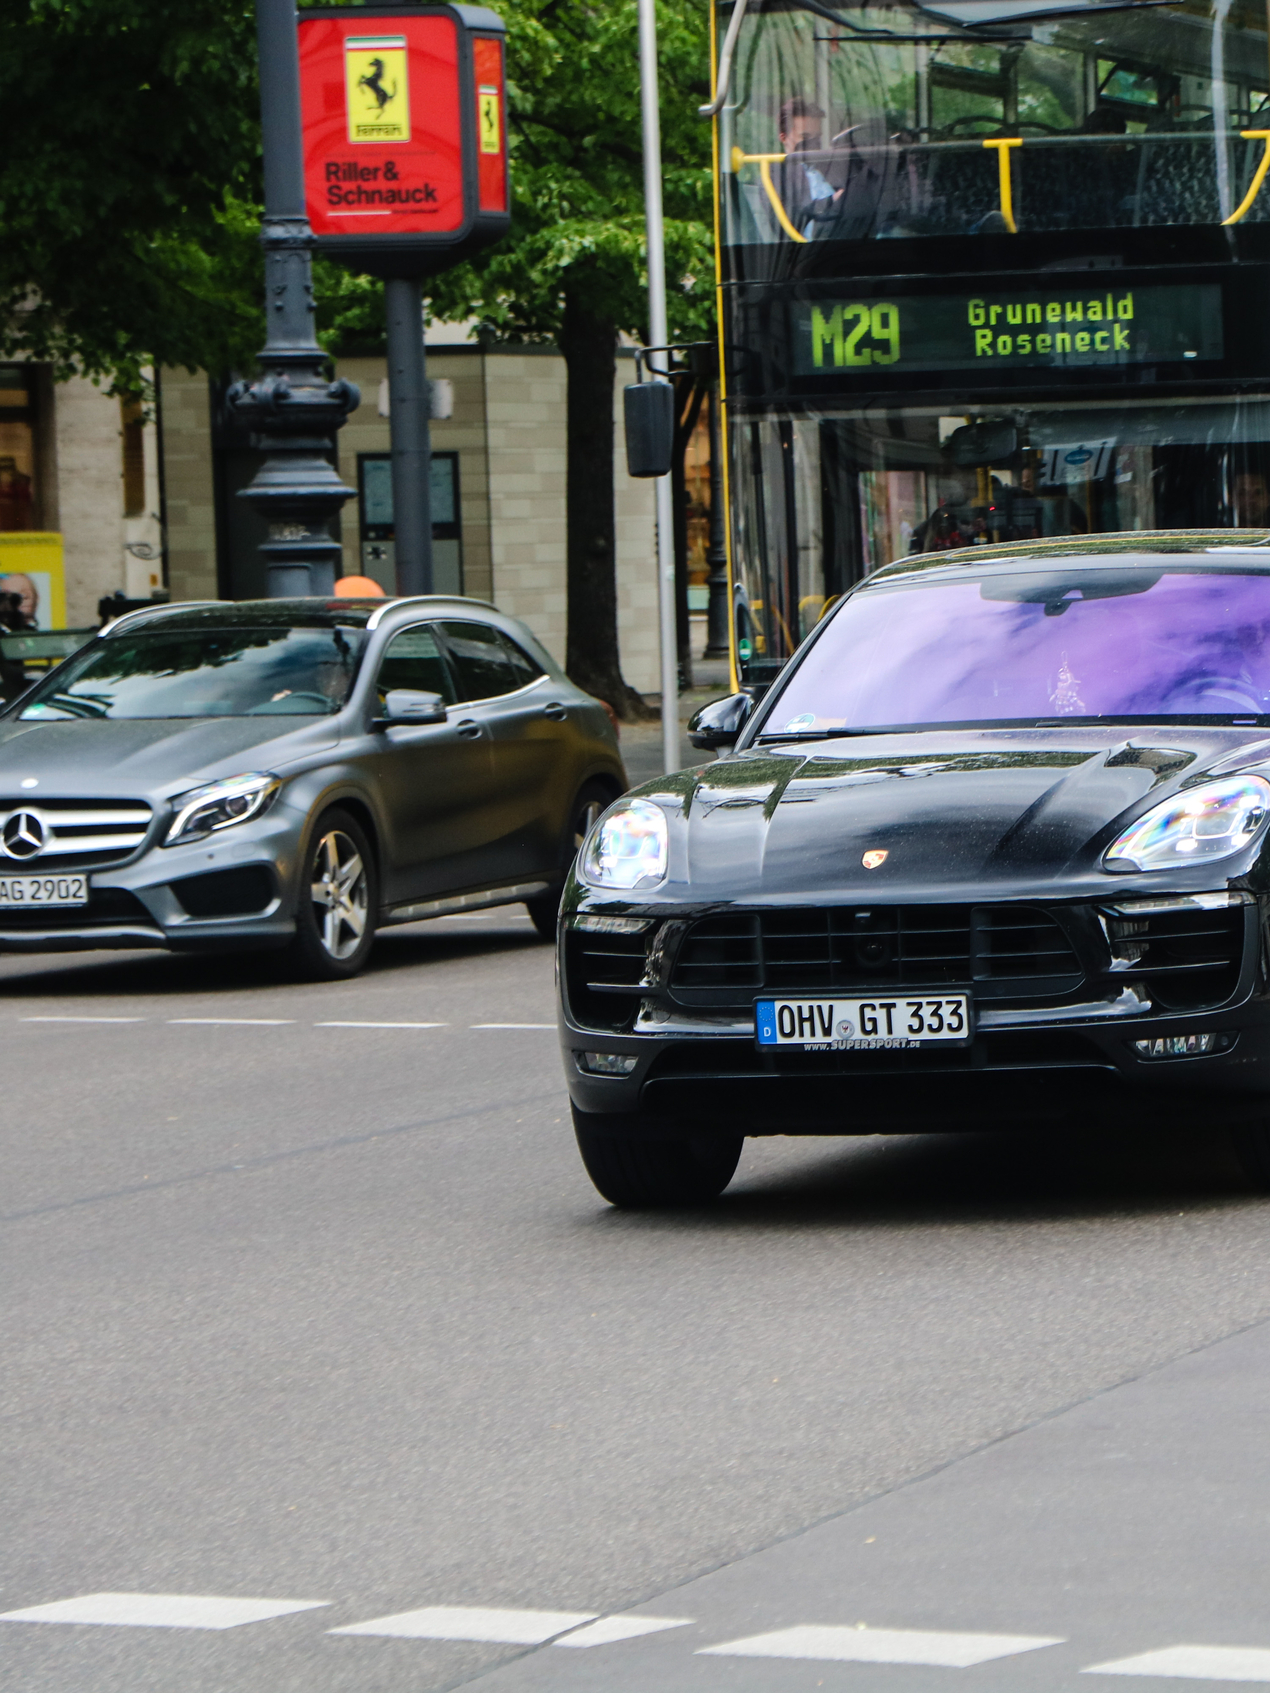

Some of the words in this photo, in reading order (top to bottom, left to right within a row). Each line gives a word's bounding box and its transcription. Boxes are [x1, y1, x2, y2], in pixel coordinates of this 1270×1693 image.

[325, 162, 380, 182] Riller
[383, 161, 399, 181] &
[327, 183, 437, 206] Schnauck
[967, 292, 1134, 326] Grunewald
[811, 302, 900, 367] M29
[974, 323, 1130, 356] Roseneck
[30, 879, 84, 900] 2902
[763, 1027, 771, 1037] D
[777, 1004, 833, 1038] OHV
[859, 1002, 896, 1036] GT
[905, 1000, 964, 1034] 333
